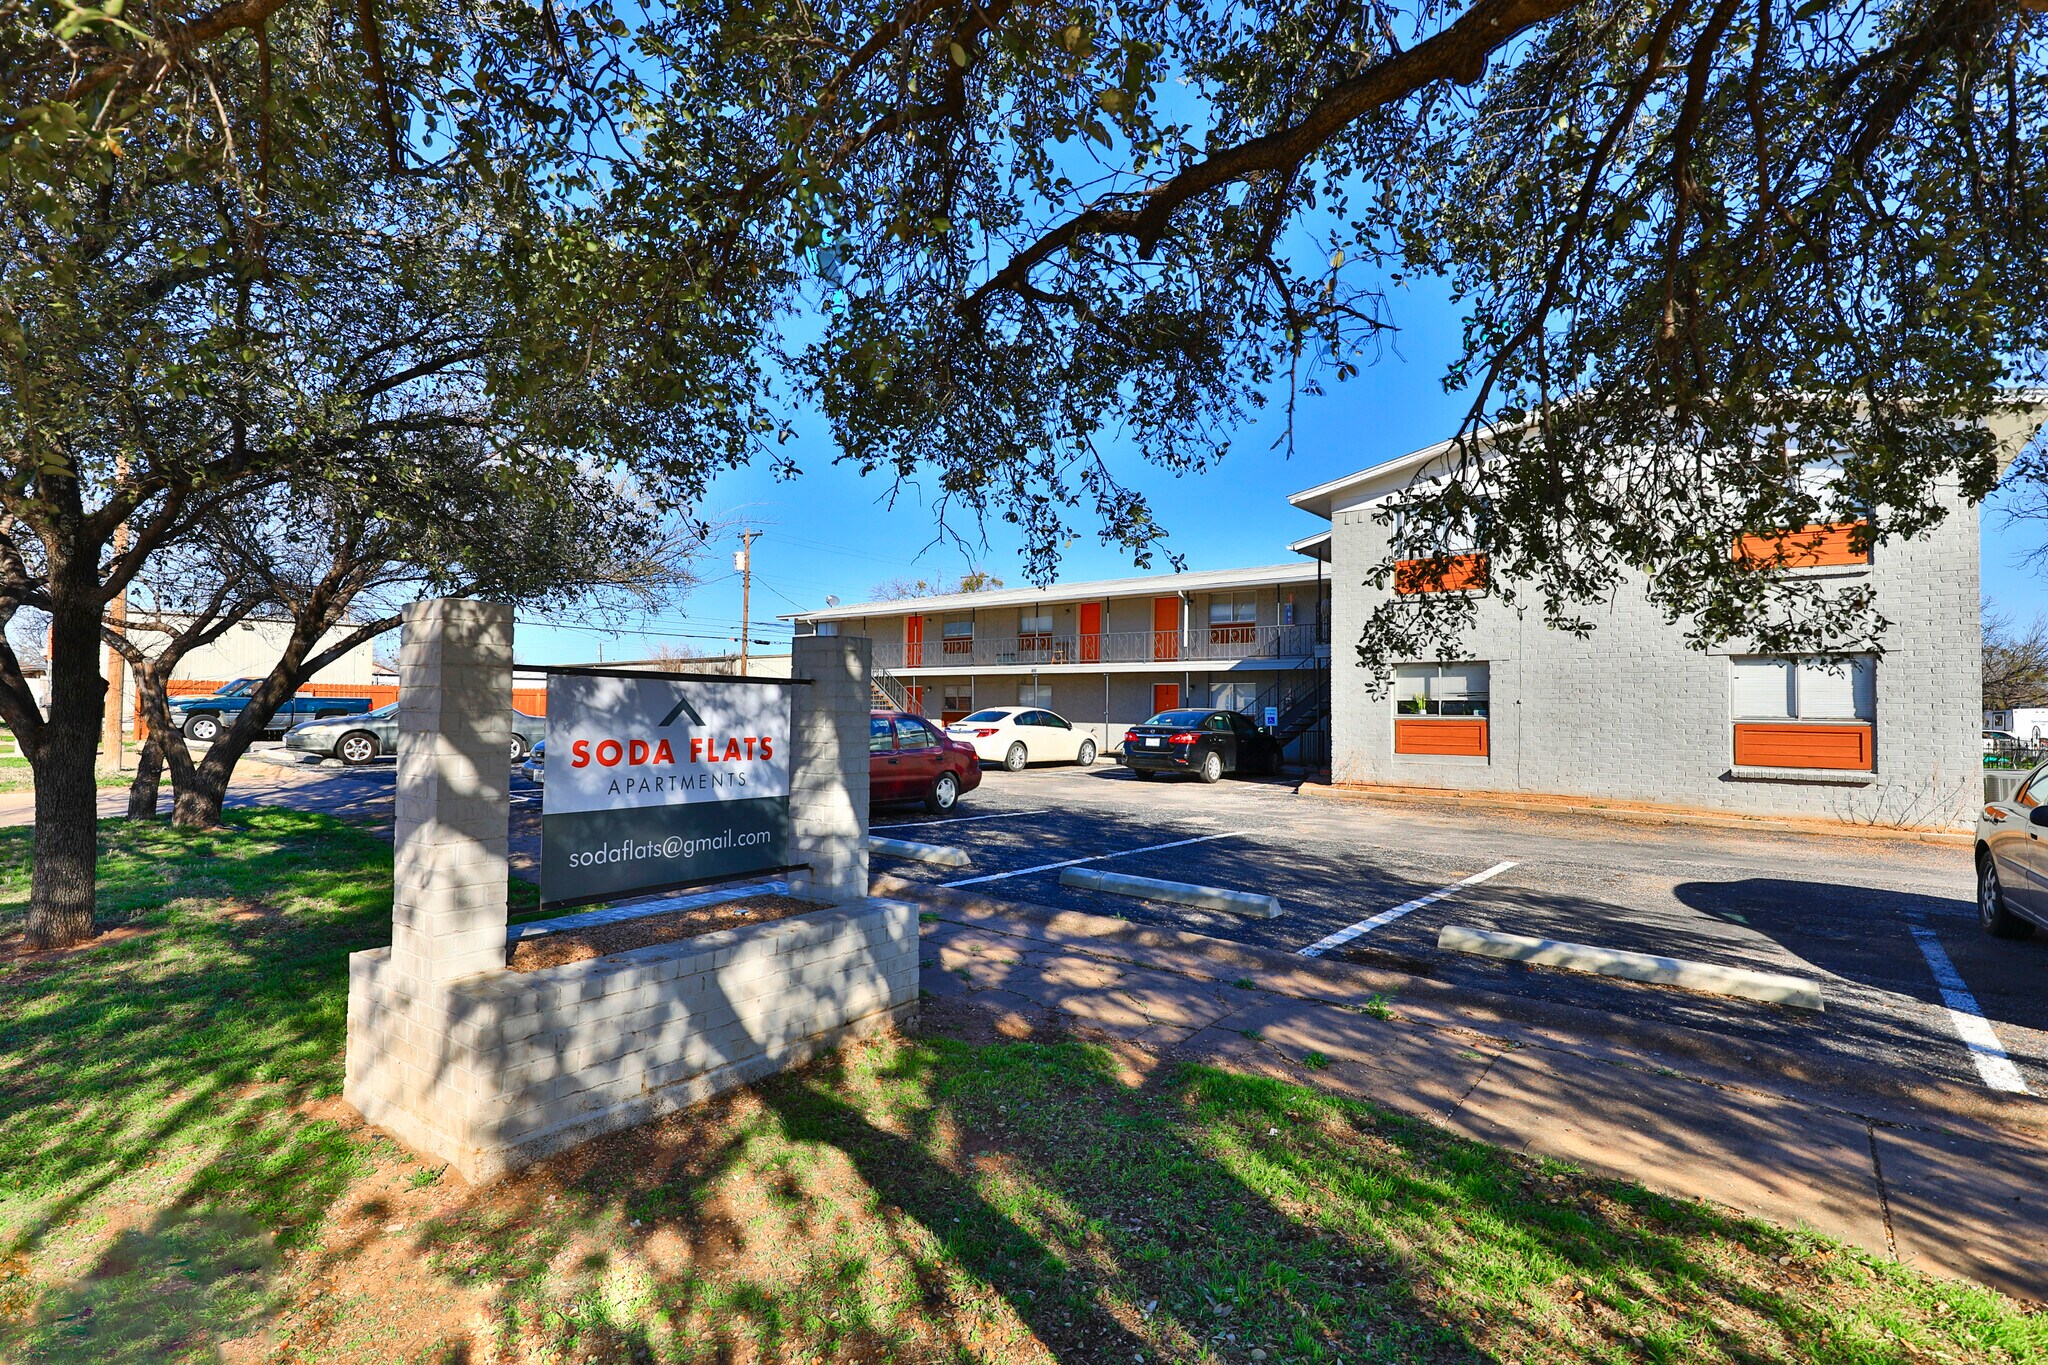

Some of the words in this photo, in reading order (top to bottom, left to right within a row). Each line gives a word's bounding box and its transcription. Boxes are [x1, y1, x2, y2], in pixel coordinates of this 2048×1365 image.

[572, 739, 675, 768] SODA
[690, 737, 773, 763] FLATS
[607, 772, 746, 795] APARTMENTS
[569, 828, 771, 868] sodaflats@gmail.com
